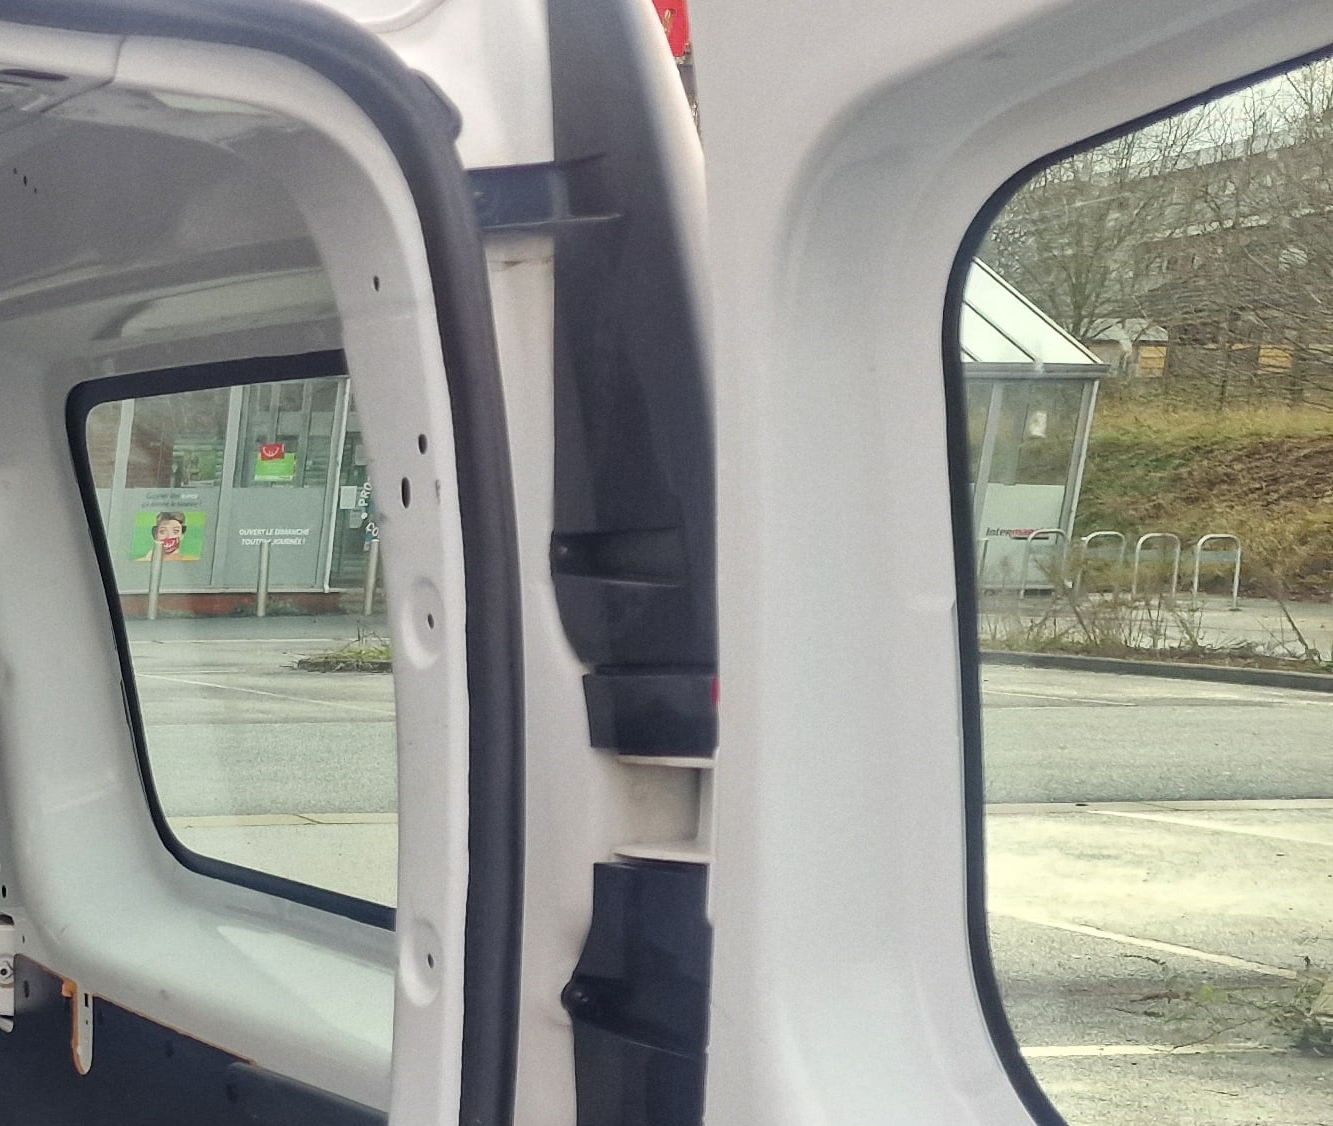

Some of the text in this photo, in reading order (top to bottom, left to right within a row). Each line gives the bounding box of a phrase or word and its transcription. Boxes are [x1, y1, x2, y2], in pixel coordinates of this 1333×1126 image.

[239, 528, 310, 536] OUVERT LE DIMANCHE
